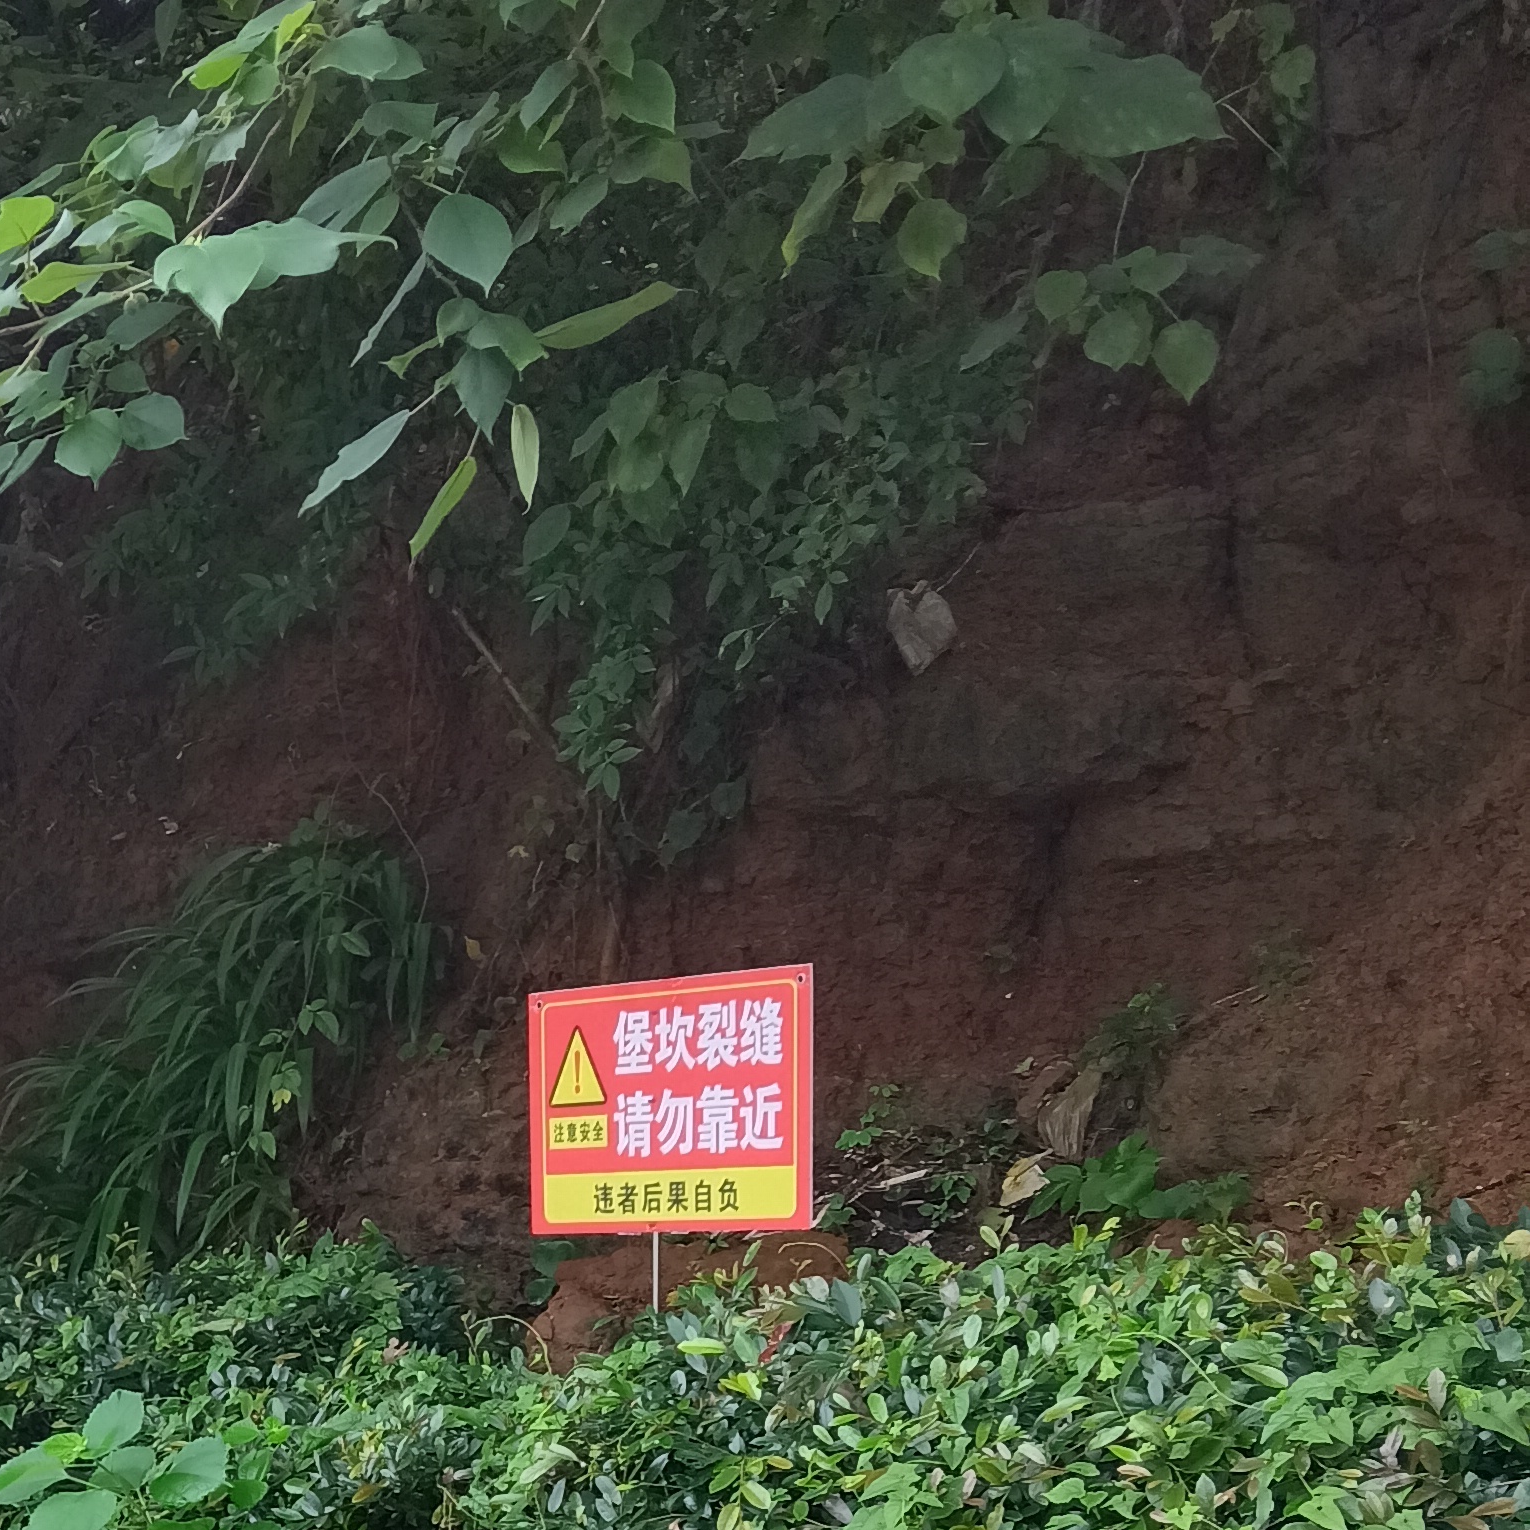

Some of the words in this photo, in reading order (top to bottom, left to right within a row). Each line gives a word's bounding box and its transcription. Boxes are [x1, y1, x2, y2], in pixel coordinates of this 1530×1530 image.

[613, 997, 783, 1075] 堡坎裂缝
[553, 1121, 604, 1143] 注意安全
[613, 1083, 783, 1157] 请勿靠近
[593, 1178, 740, 1214] 违者后果自负
